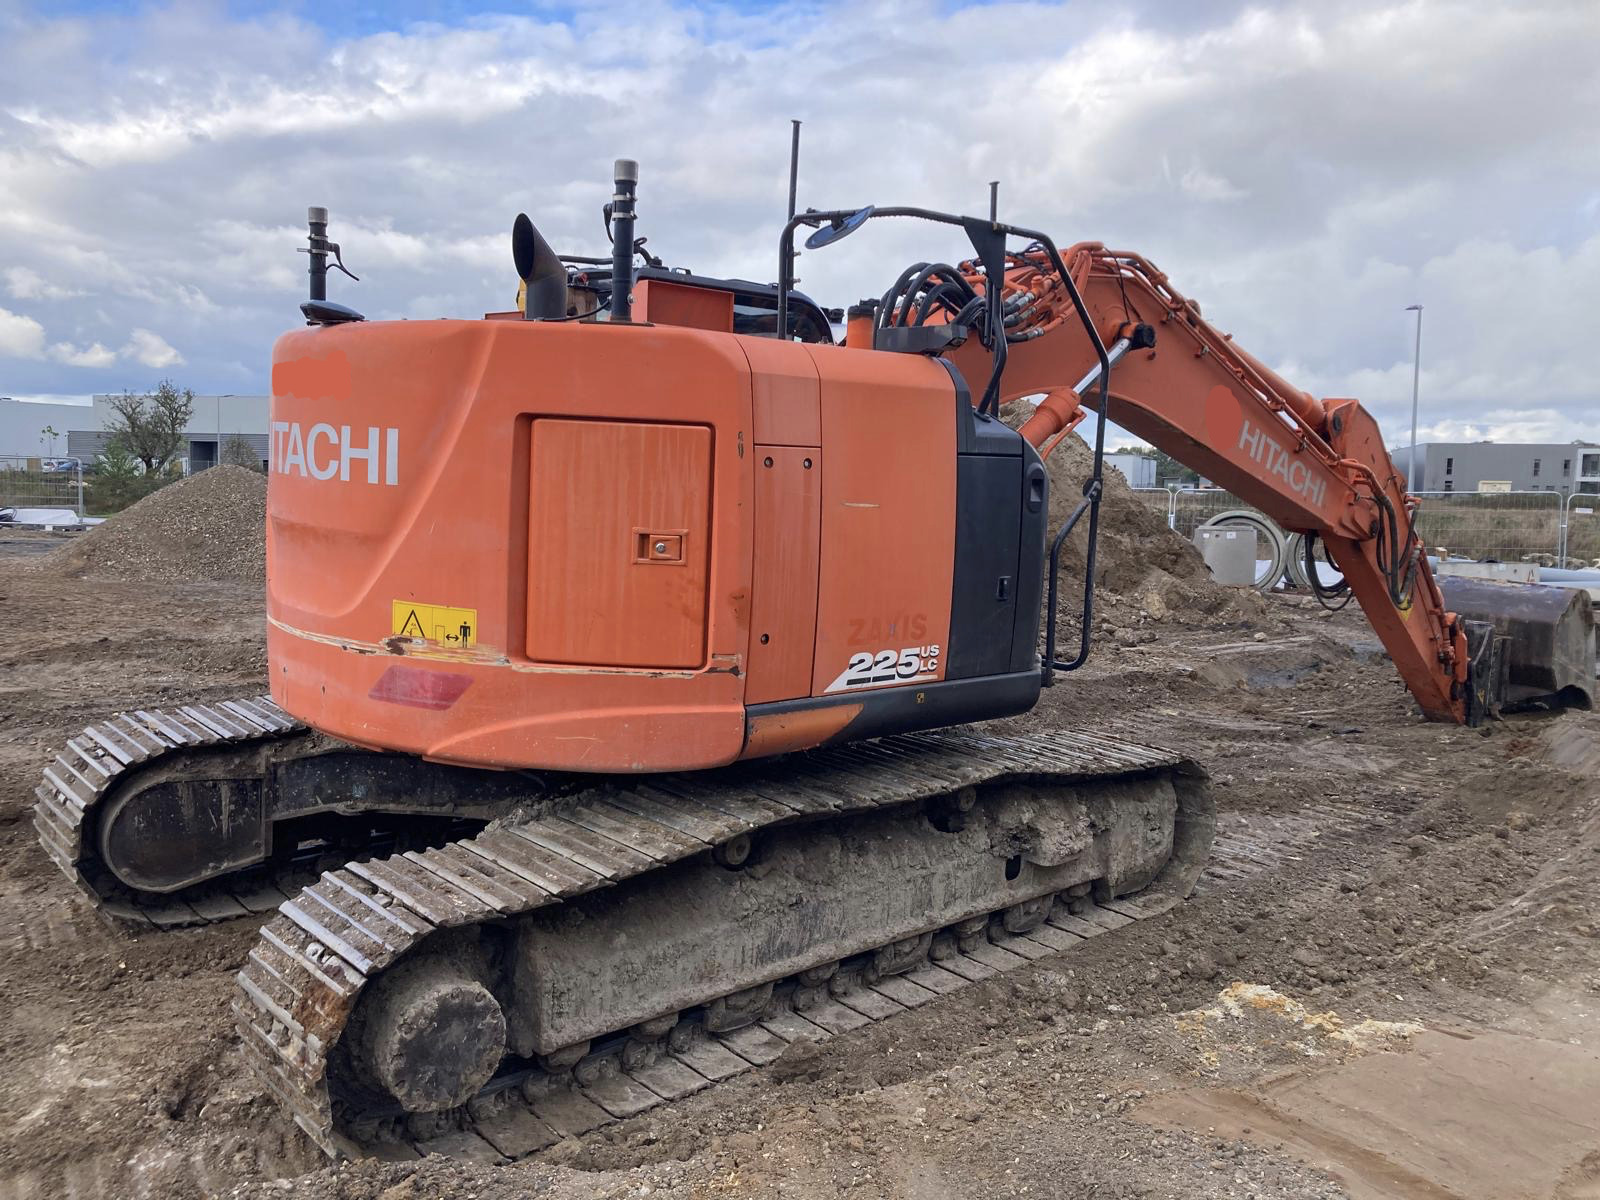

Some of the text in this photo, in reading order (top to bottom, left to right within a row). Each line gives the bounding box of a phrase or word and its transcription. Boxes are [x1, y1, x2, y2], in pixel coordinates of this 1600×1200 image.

[1238, 420, 1326, 507] HITACHI
[848, 644, 940, 678] 225 US
[919, 658, 938, 672] LC
